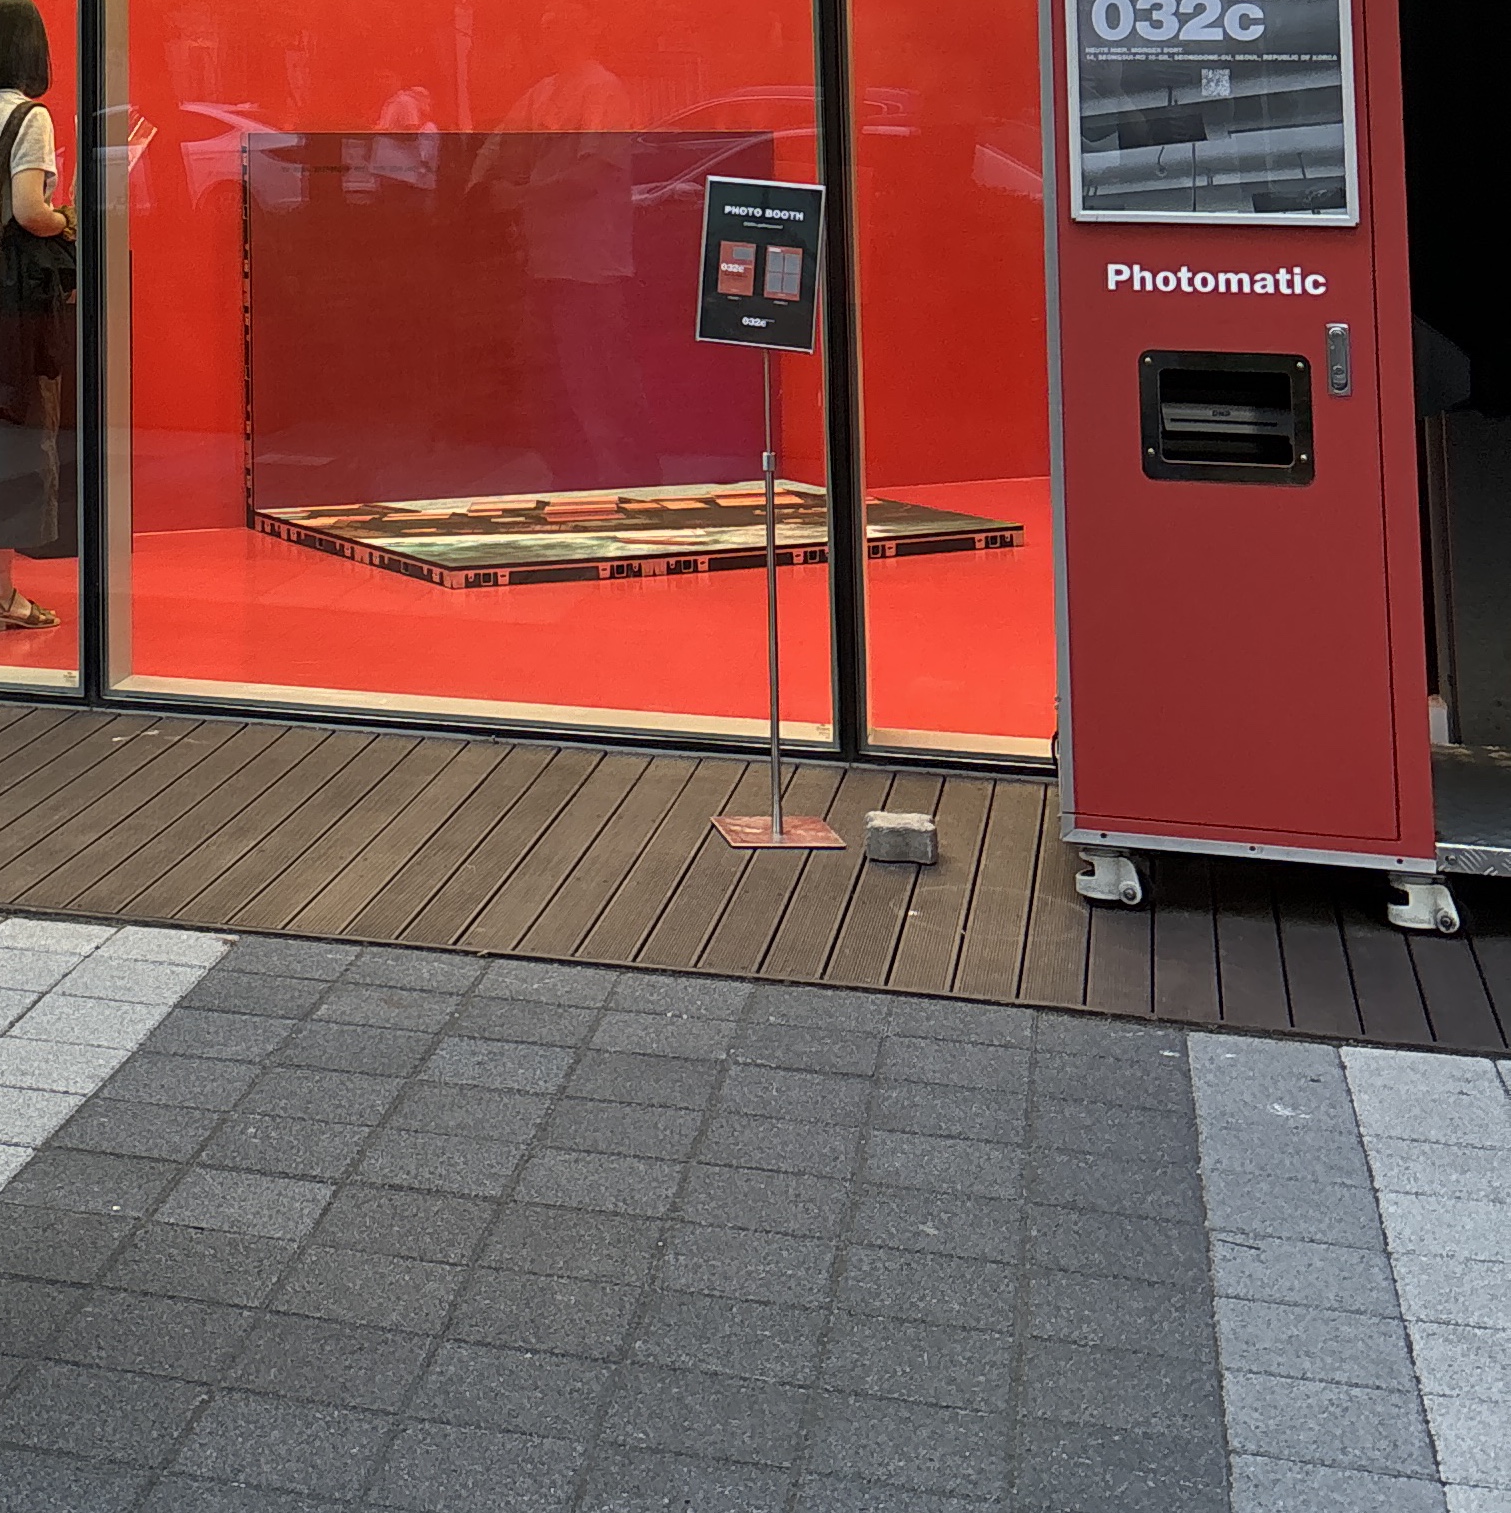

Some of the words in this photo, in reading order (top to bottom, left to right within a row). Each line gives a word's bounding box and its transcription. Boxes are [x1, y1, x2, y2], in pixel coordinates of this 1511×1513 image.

[724, 205, 763, 217] PHOTO
[765, 209, 804, 221] BOOTH
[1107, 263, 1327, 295] Photomatic
